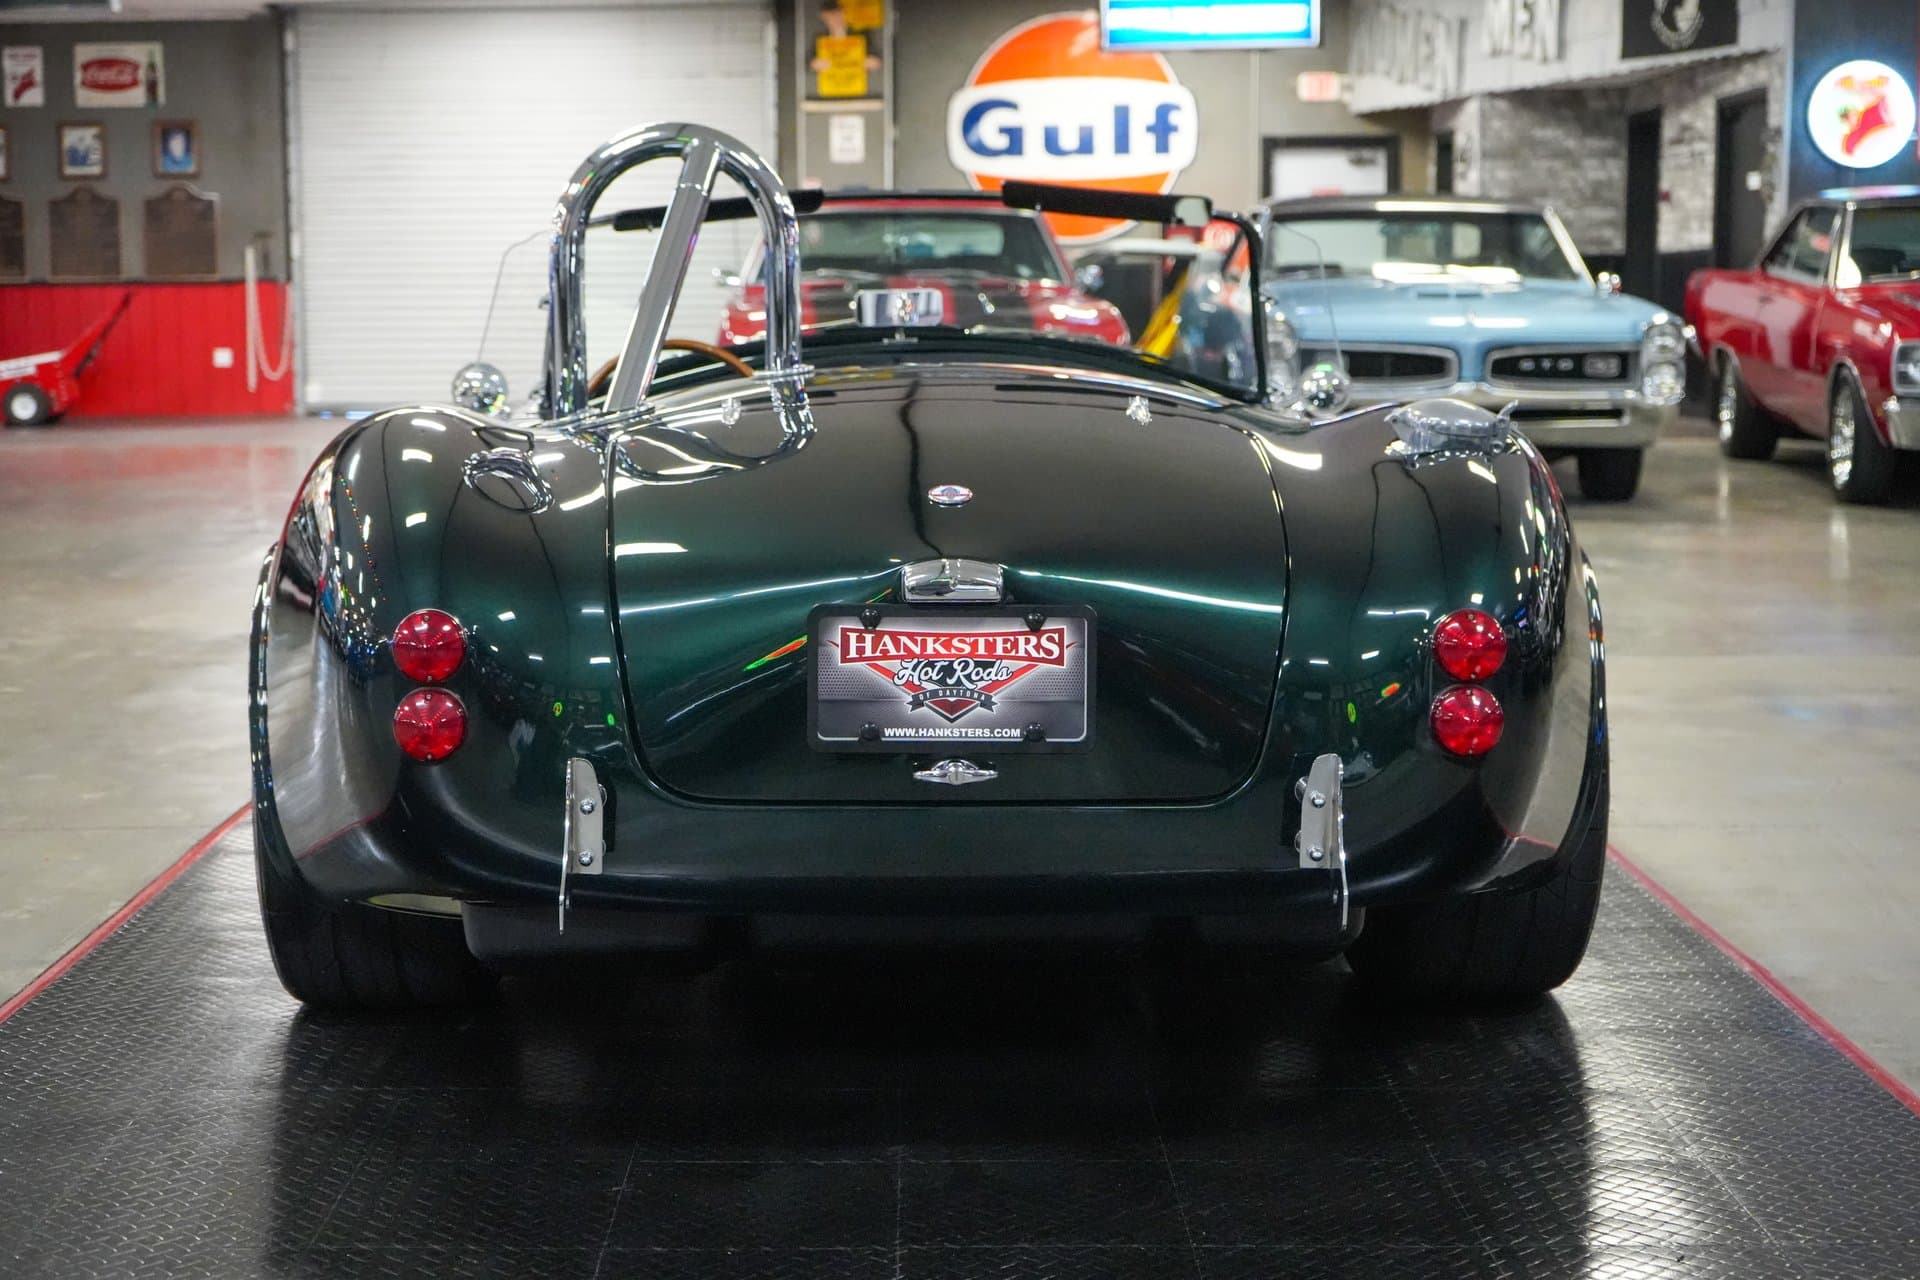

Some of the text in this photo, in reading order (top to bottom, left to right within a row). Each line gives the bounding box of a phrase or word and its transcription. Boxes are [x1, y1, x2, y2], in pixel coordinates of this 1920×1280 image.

[962, 98, 1182, 157] Gulf
[846, 631, 1061, 660] HANKSTERS
[893, 658, 1013, 690] Hot Rods
[884, 727, 1021, 738] WWW.HANKSTERS.COM
